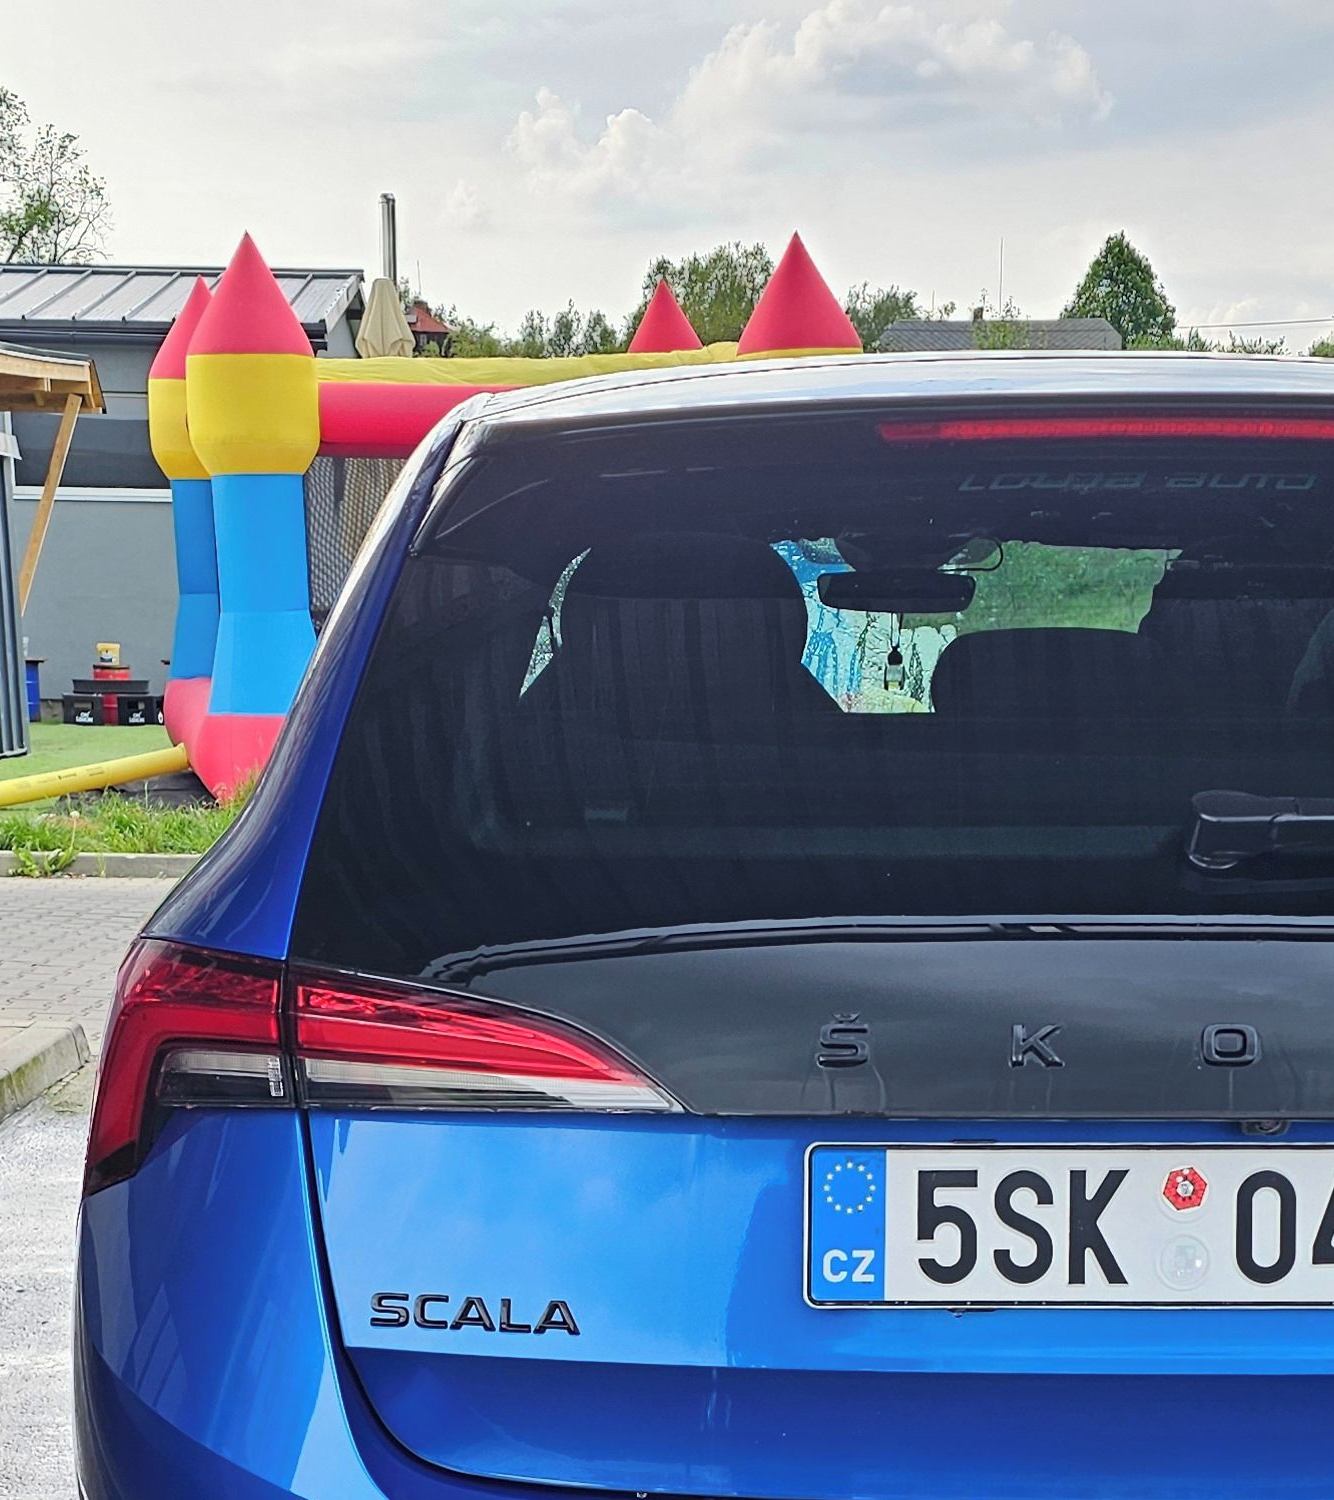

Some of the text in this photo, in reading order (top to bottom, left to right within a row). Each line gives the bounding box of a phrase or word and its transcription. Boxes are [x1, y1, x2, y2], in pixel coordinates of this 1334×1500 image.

[916, 1168, 1130, 1286] 5SK
[822, 1249, 875, 1285] CZ
[369, 1291, 581, 1336] SCALA
